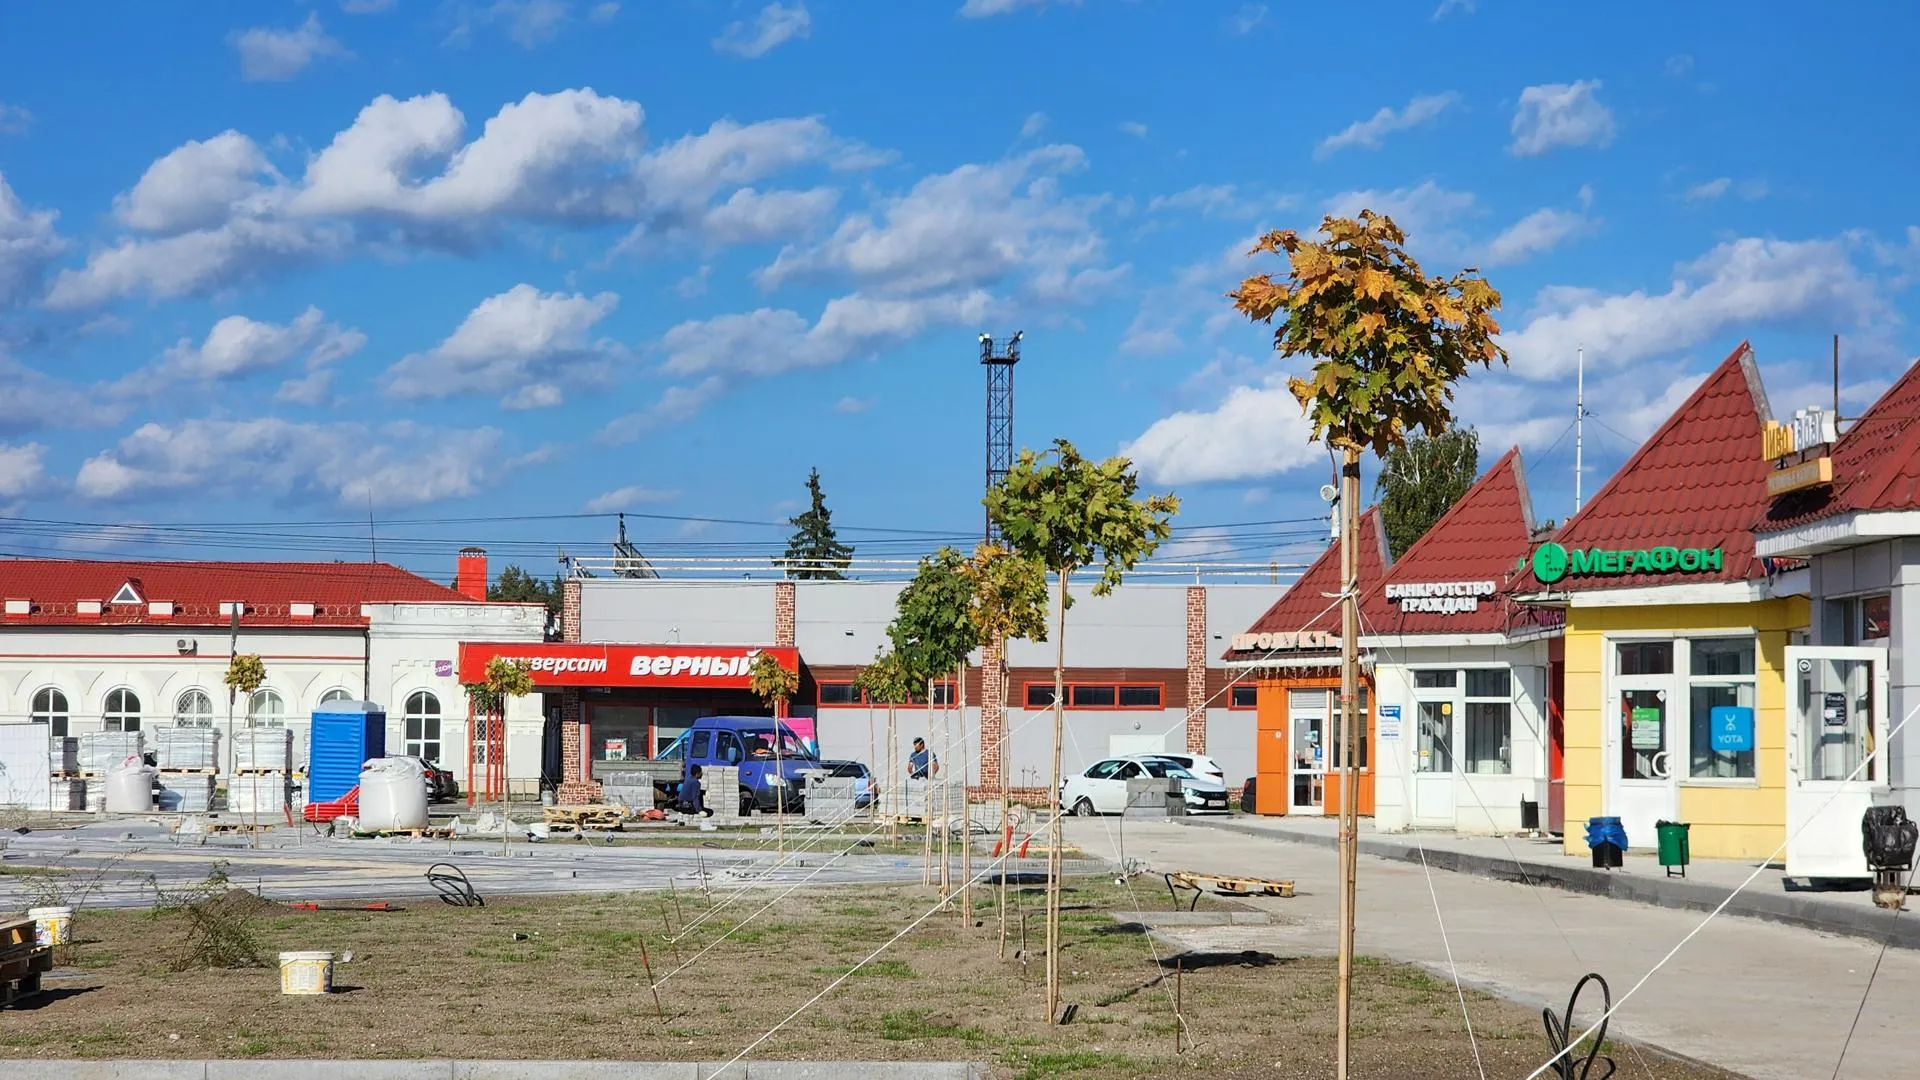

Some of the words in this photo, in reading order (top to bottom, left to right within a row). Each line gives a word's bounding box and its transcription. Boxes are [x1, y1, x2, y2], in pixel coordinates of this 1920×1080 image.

[1571, 546, 1722, 573] МЕГАФОН
[1385, 581, 1496, 598] БАНКРОТСТВО
[1401, 597, 1478, 615] ГРАЖДАН
[1718, 735, 1744, 744] YOTA
